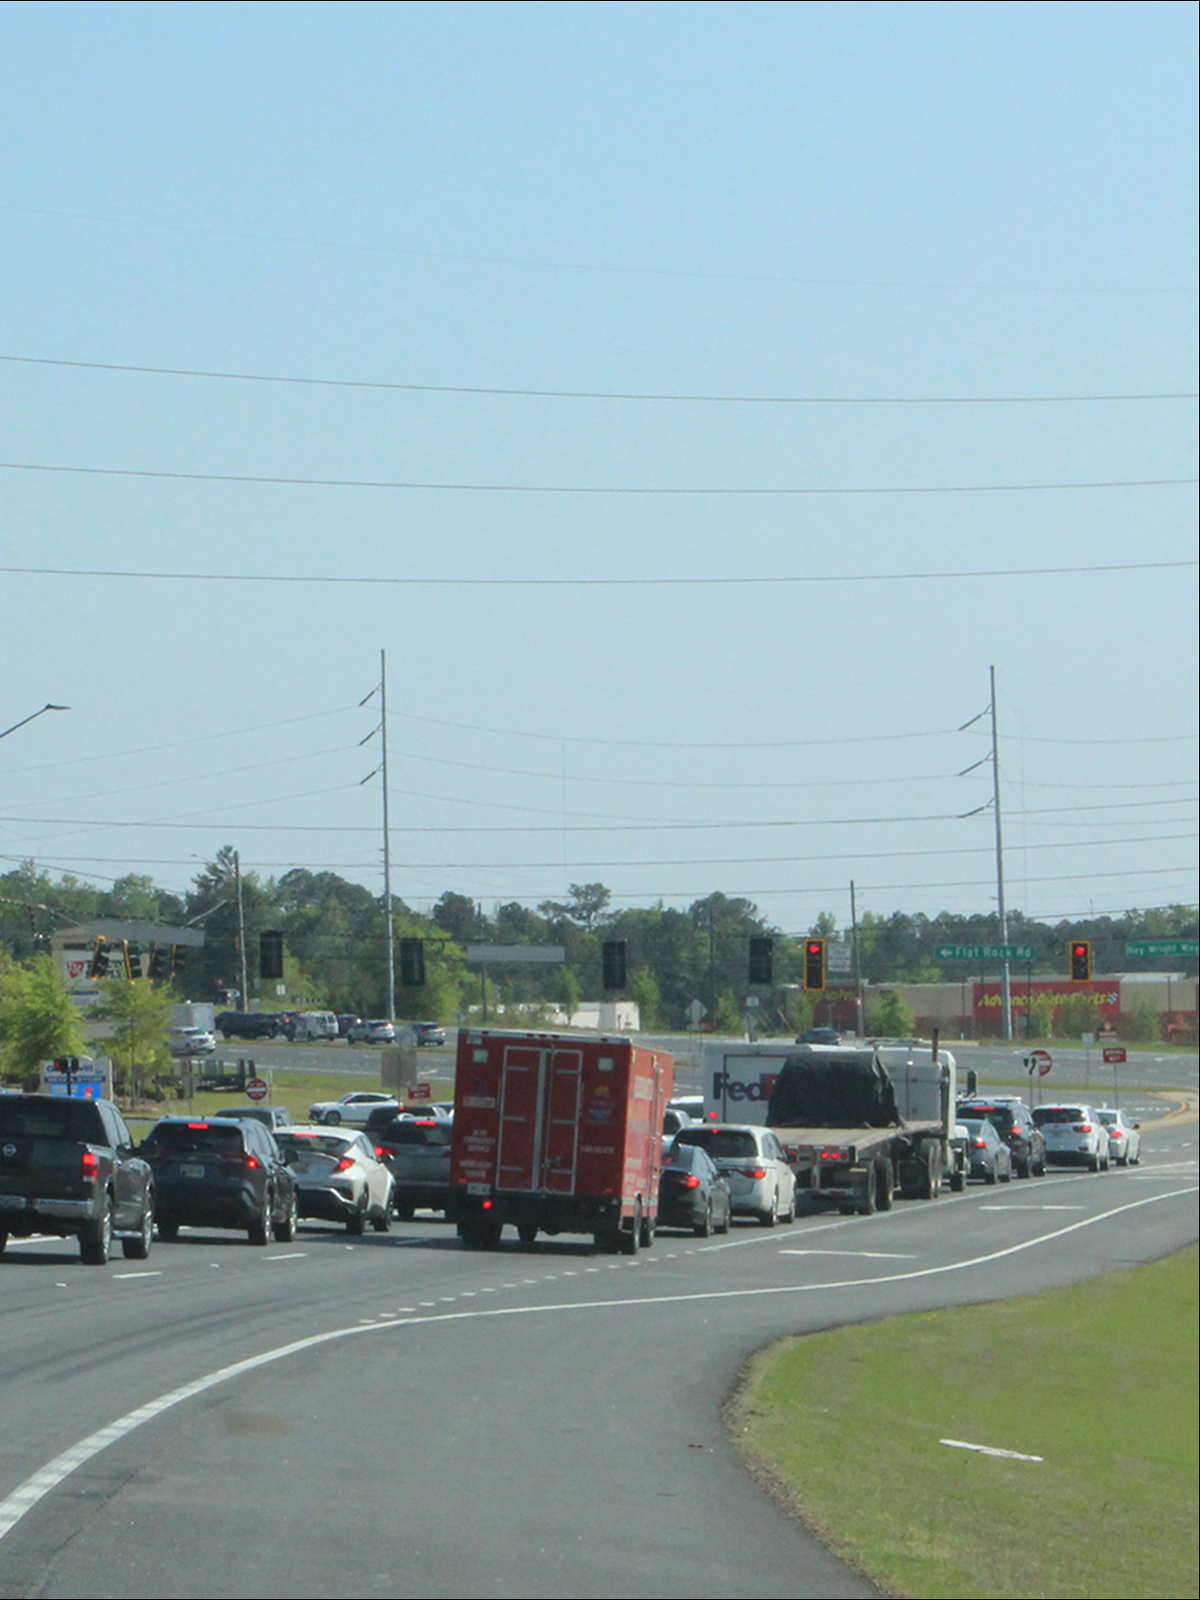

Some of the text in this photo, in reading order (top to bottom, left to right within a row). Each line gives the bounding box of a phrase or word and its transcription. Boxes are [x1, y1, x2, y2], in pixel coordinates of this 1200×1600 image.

[955, 945, 1031, 958] Flat Rock Rd
[978, 994, 1034, 1006] Advnce
[714, 1072, 781, 1102] FedE
